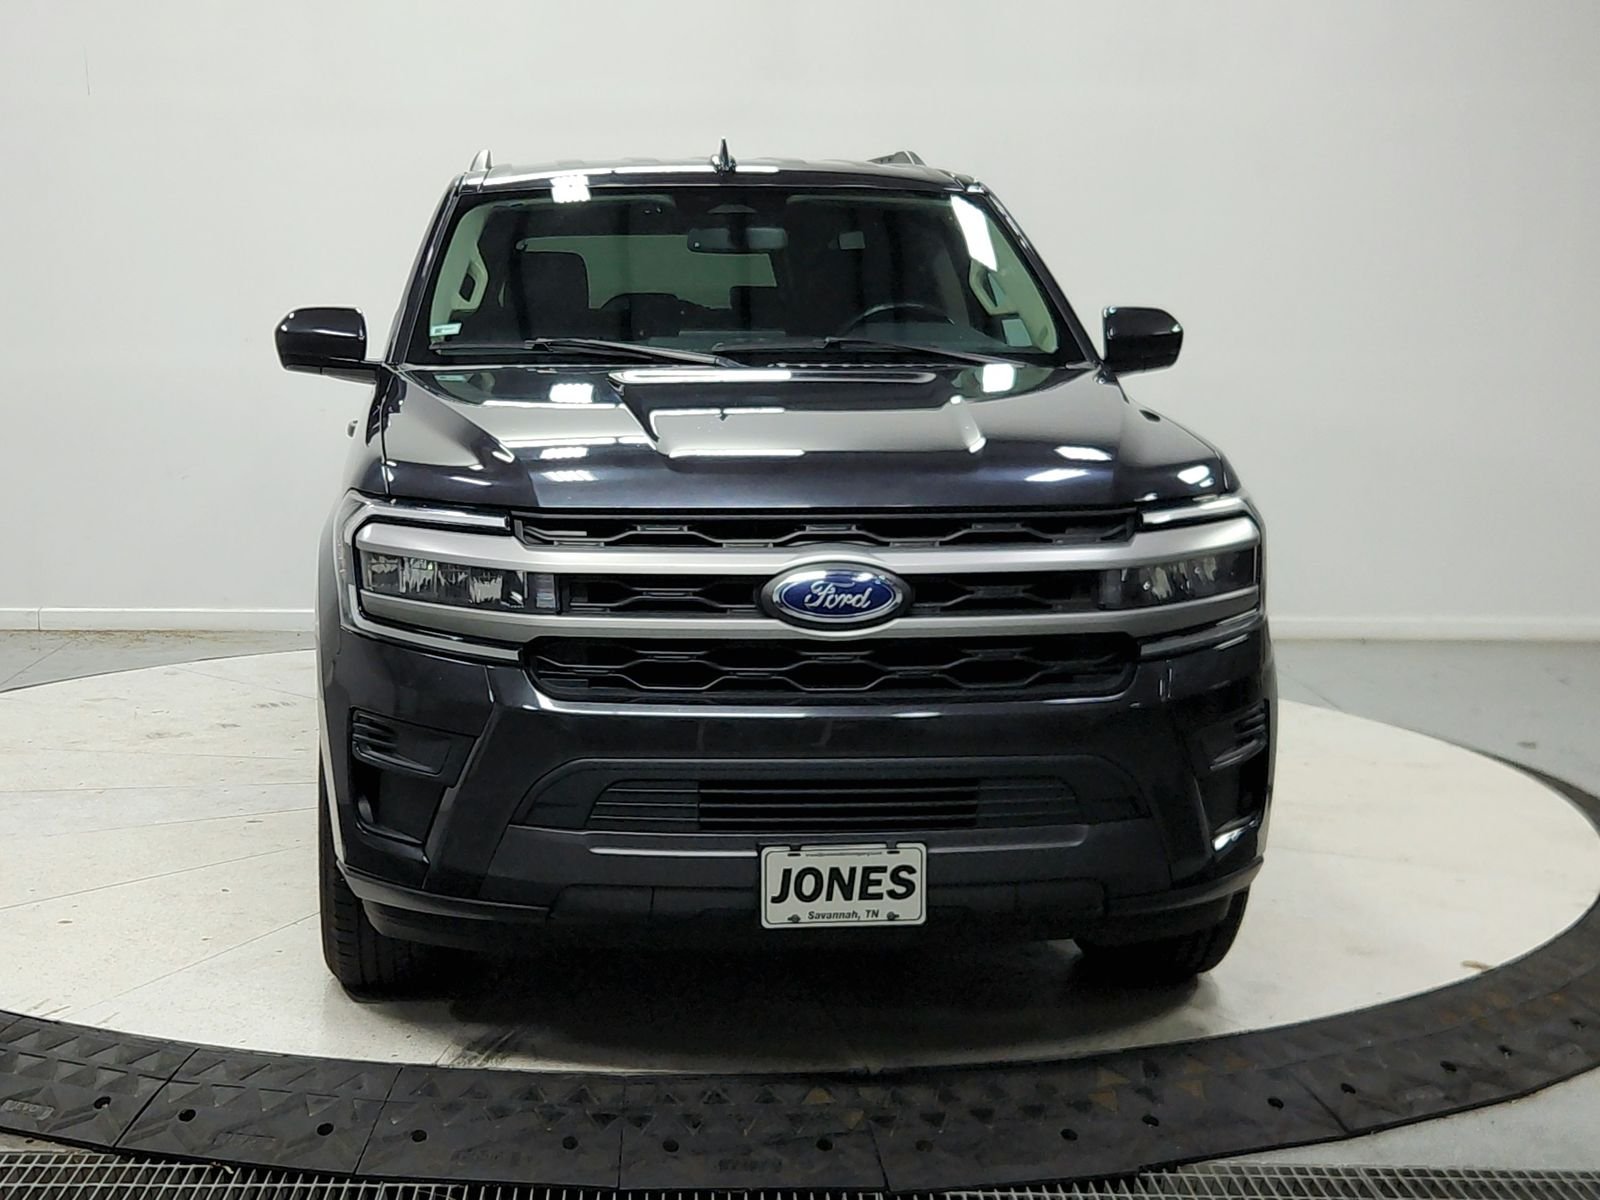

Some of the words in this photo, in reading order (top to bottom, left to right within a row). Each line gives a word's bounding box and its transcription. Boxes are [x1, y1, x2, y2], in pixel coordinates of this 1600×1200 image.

[804, 580, 872, 609] Ford
[770, 864, 917, 904] JONES
[807, 910, 861, 920] Savannah,
[865, 909, 880, 918] TN
